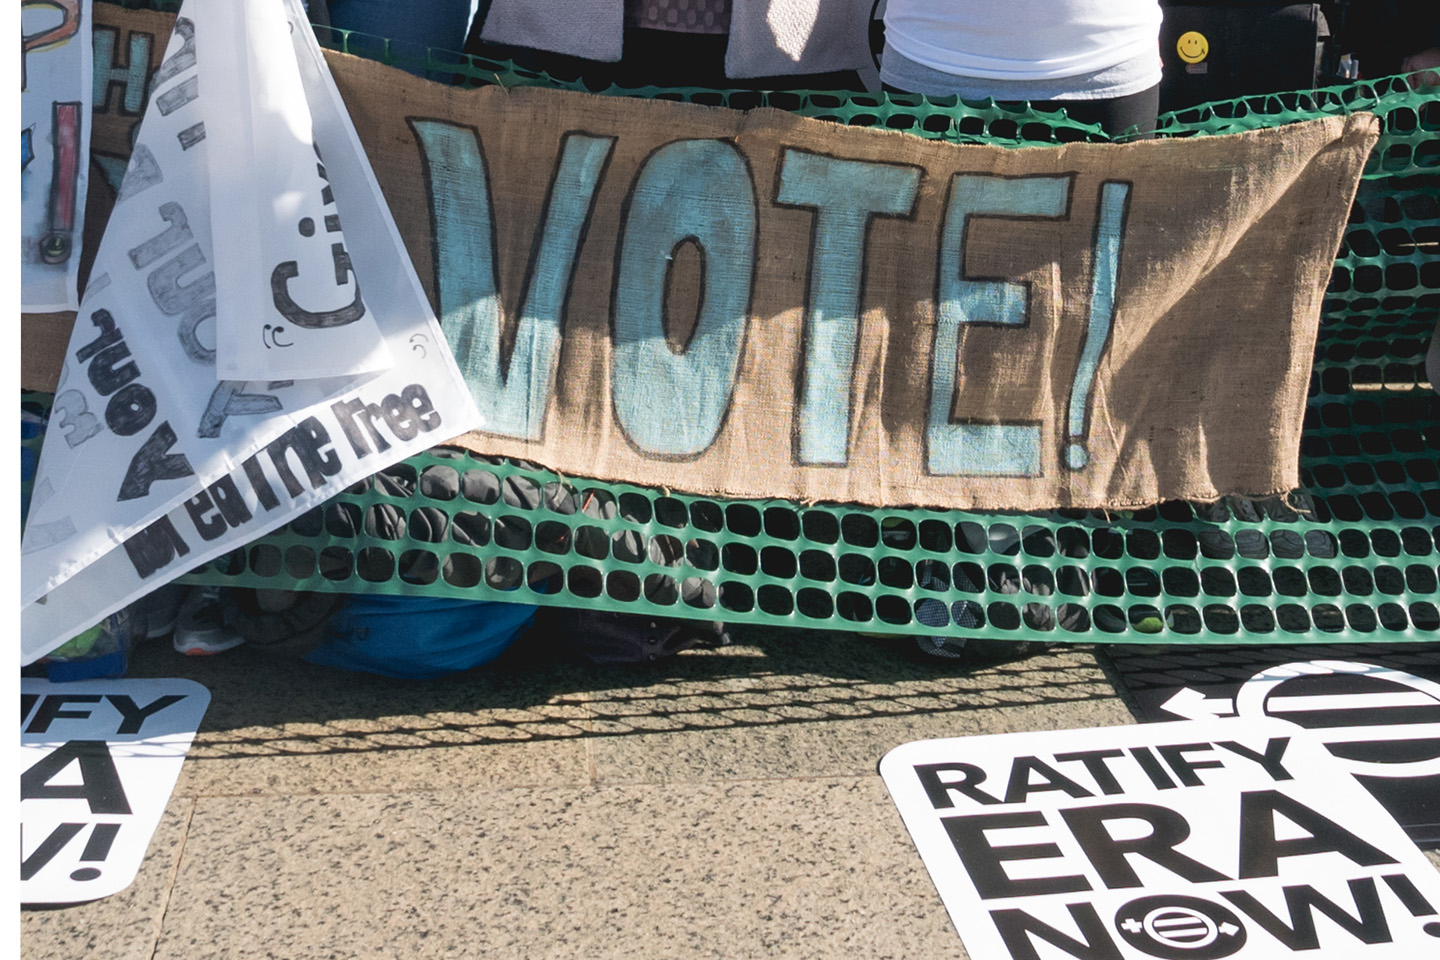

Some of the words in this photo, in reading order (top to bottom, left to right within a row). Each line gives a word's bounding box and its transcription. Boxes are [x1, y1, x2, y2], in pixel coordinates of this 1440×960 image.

[406, 116, 1132, 477] VOTE!
[75, 307, 195, 503] Your
[913, 737, 1295, 810] RATIFY
[940, 789, 1402, 900] ERA
